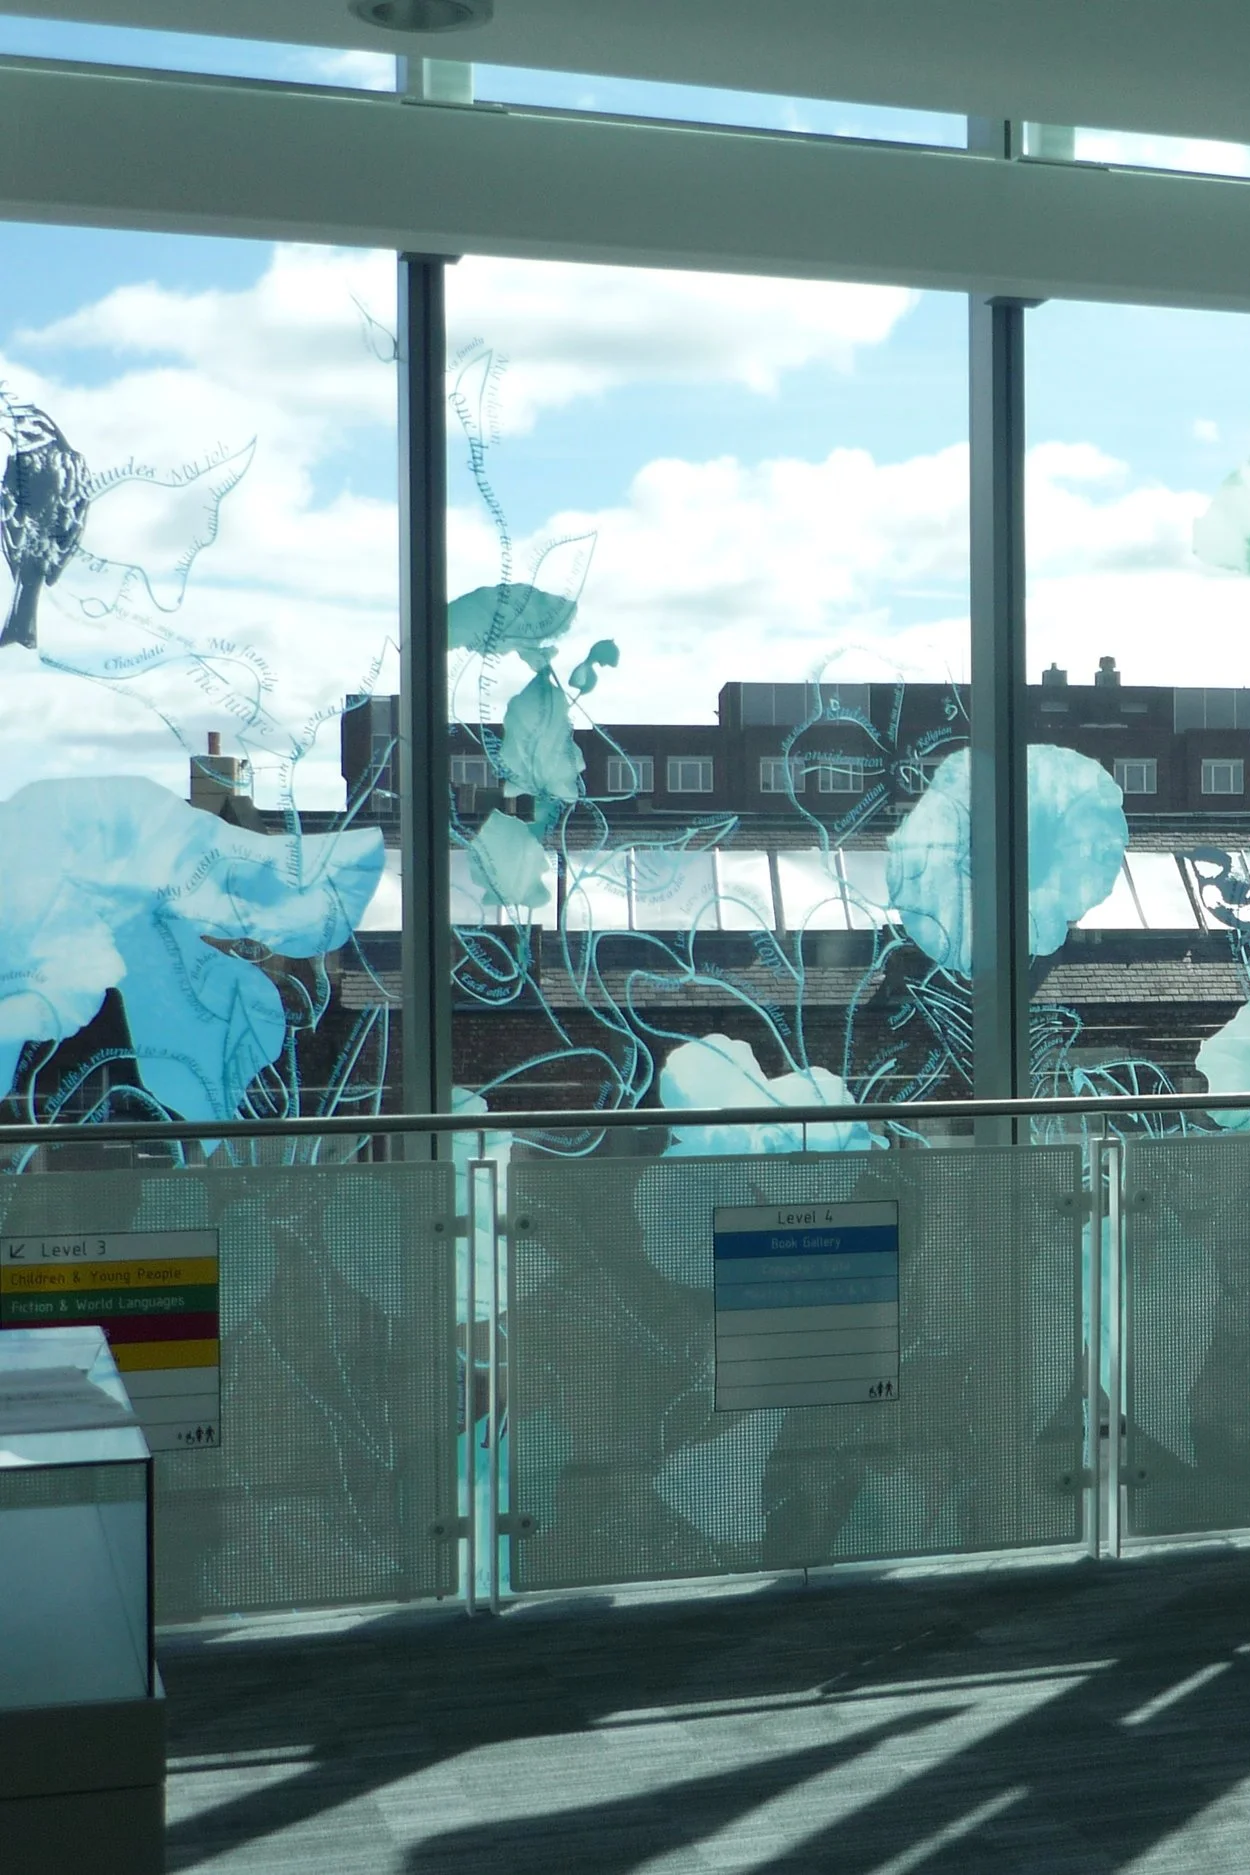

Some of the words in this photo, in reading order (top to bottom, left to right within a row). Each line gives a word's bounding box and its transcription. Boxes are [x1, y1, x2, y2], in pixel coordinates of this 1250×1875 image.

[467, 436, 489, 476] day
[478, 479, 508, 530] more
[778, 1211, 816, 1225] Level
[825, 1210, 834, 1223] 4
[42, 1241, 87, 1258] Level
[98, 1240, 106, 1255] 3
[771, 1237, 798, 1249] Book
[803, 1235, 841, 1249] Gallery
[11, 1272, 65, 1287] Children
[72, 1271, 81, 1284] &
[90, 1269, 131, 1285] Young
[137, 1267, 182, 1282] People
[11, 1301, 53, 1314] Fiction
[59, 1300, 68, 1313] &
[77, 1298, 113, 1312] World
[119, 1295, 186, 1311] Languages
